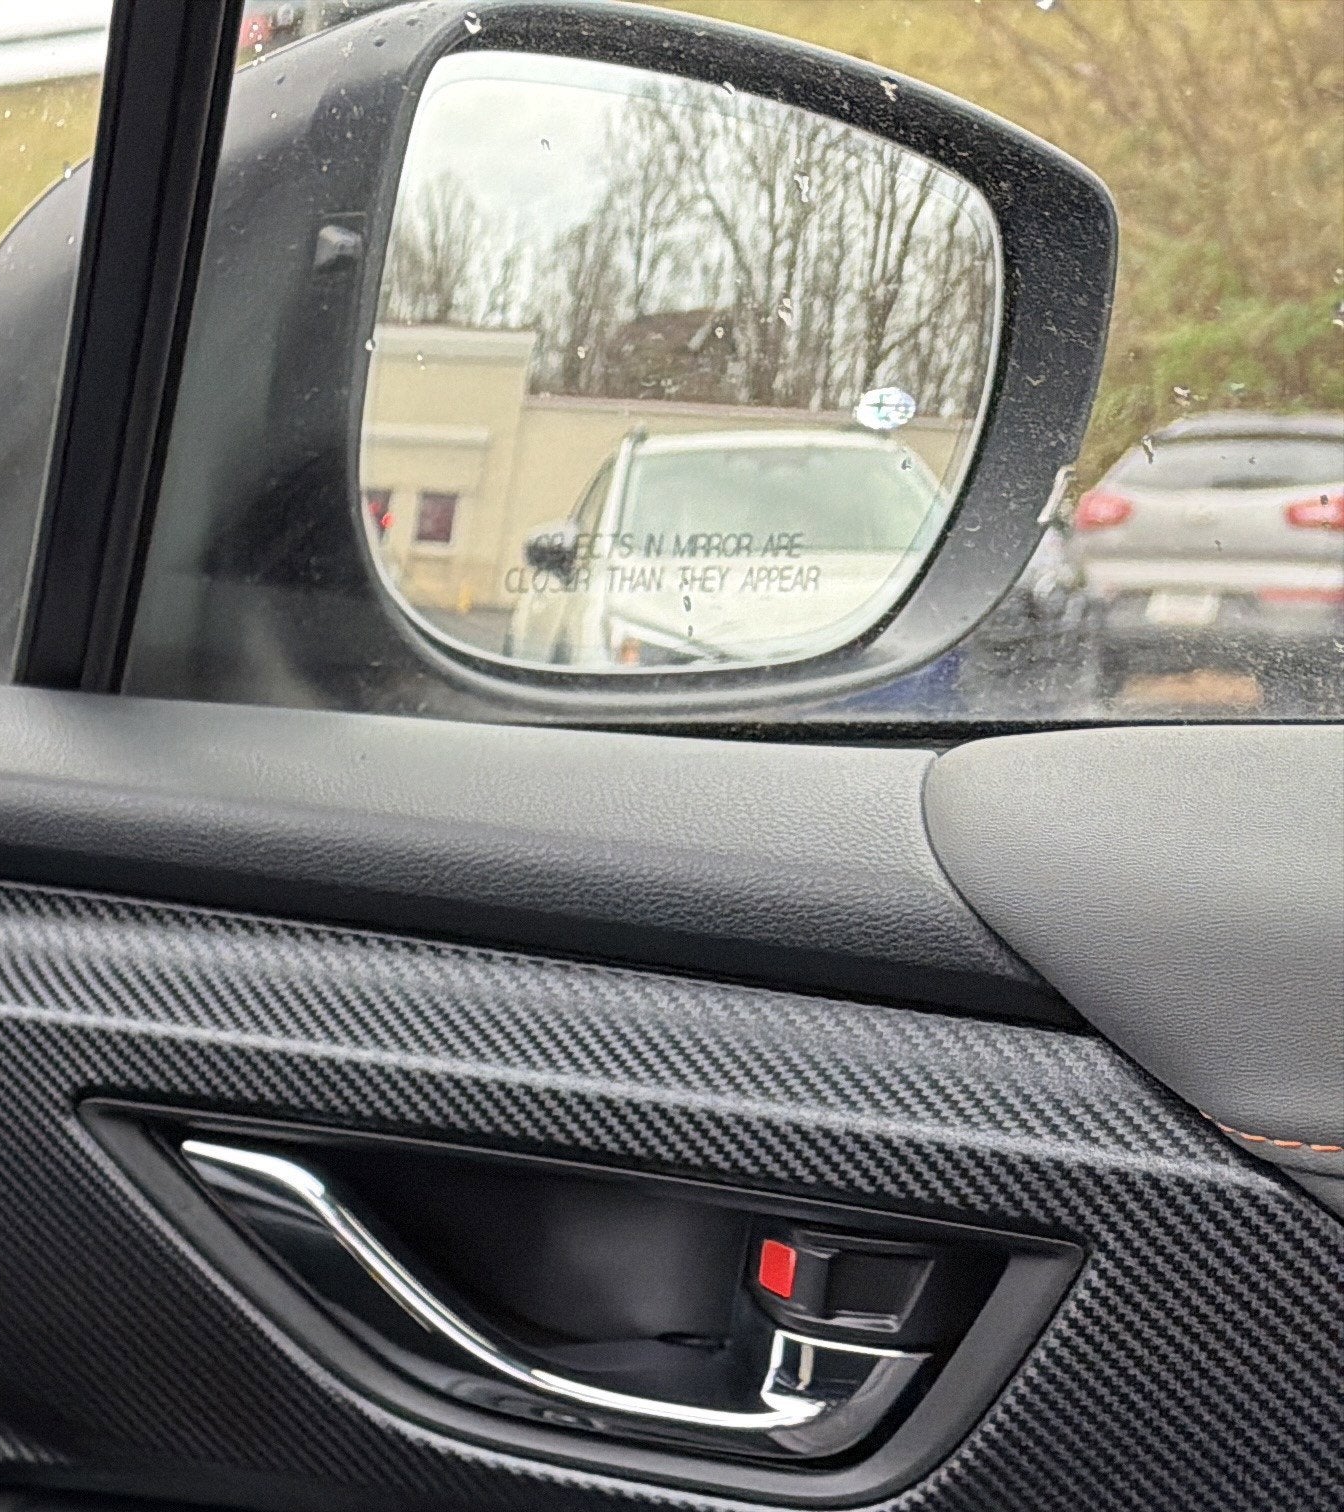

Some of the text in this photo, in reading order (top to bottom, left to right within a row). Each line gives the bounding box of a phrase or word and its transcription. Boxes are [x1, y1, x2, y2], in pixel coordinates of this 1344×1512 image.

[644, 533, 665, 558] IN
[761, 532, 804, 558] ARE
[608, 566, 663, 592] THAN
[679, 566, 731, 592] THEY
[739, 566, 822, 592] APPEAR
